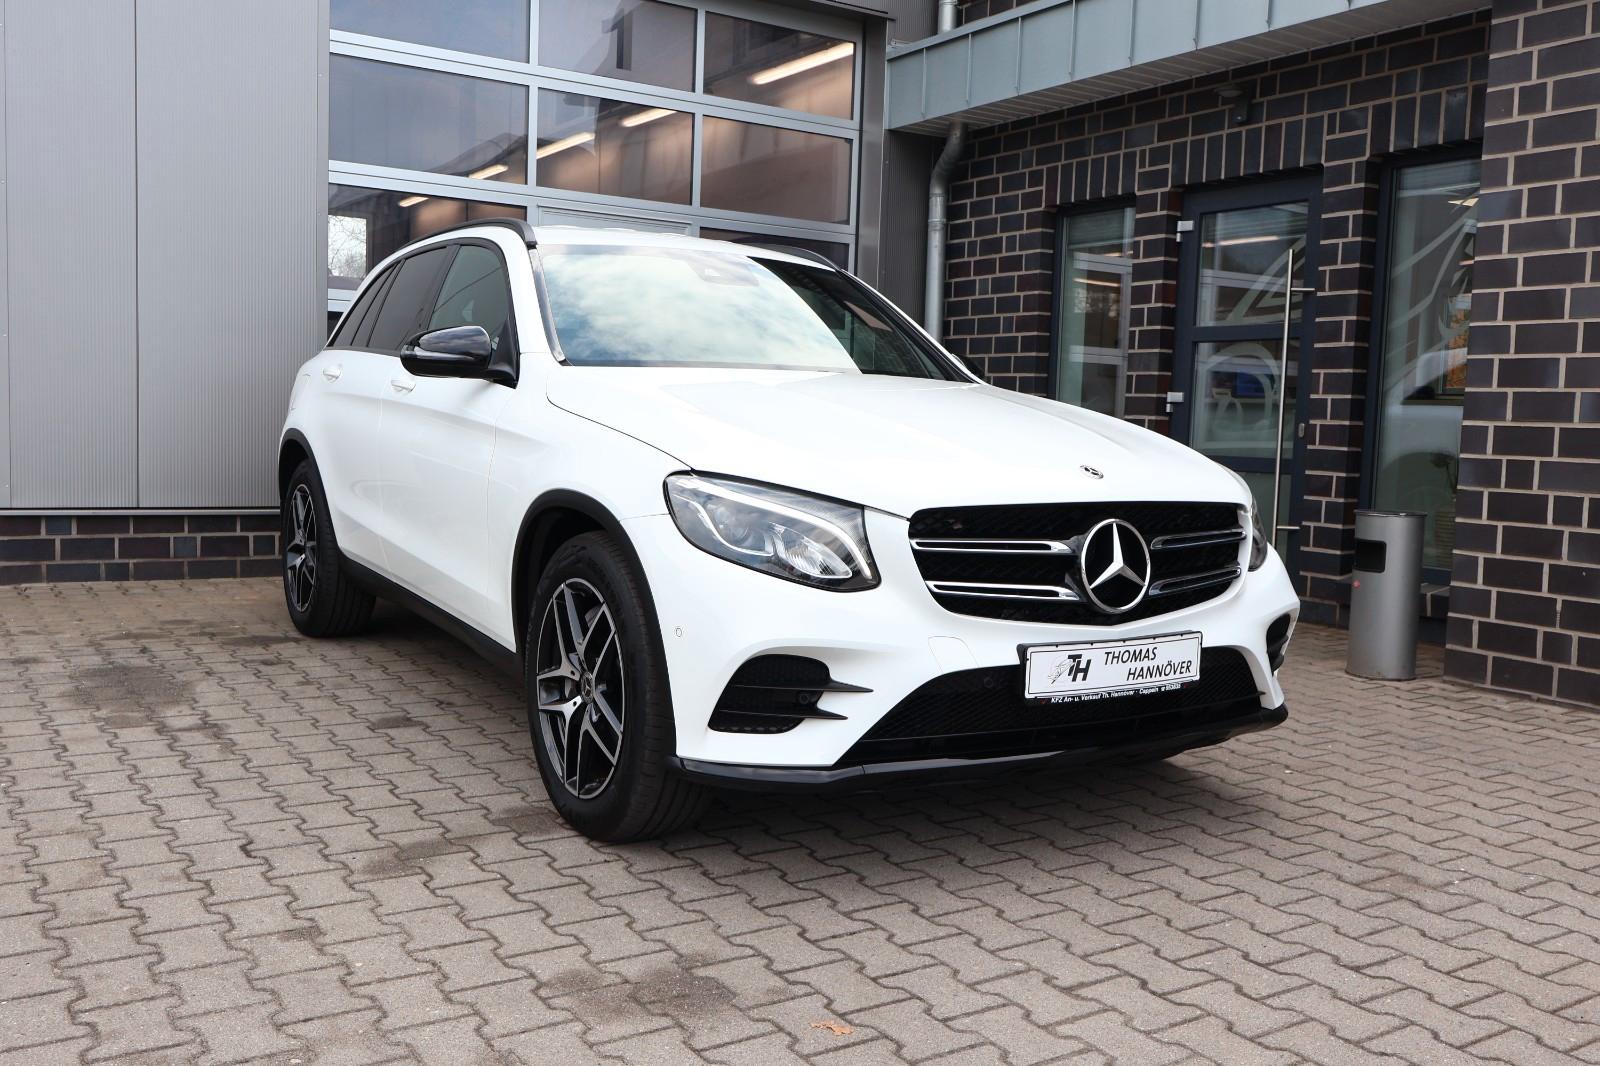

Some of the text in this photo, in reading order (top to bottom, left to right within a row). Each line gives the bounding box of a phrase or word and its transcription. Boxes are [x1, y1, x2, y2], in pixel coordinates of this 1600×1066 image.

[1104, 647, 1158, 666] THOMAS
[1068, 653, 1092, 682] TH
[1126, 660, 1193, 681] HANNÖVER
[1081, 693, 1101, 701] Verkauf
